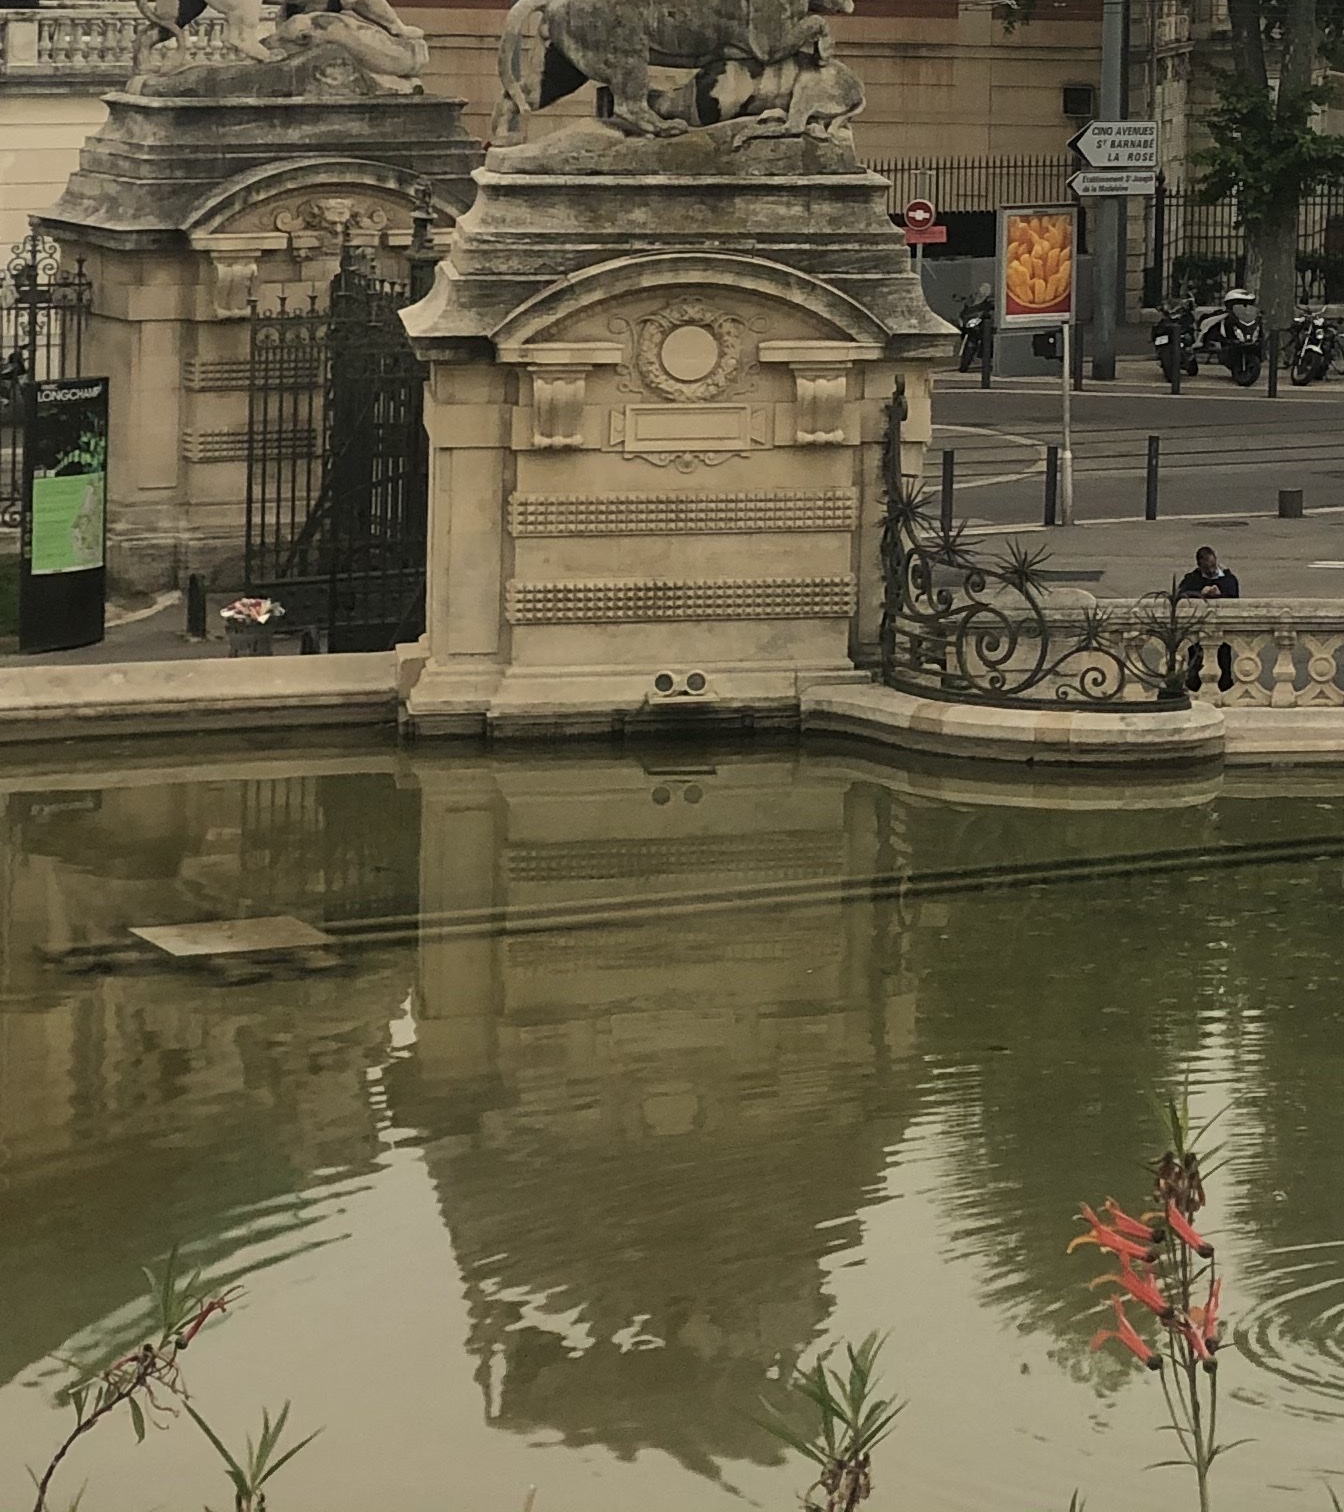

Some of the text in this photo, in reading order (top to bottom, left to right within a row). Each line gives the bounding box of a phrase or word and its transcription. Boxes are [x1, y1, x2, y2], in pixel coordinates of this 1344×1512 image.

[1115, 126, 1154, 136] AVENUES
[1110, 138, 1154, 149] BARNABÉ
[1107, 153, 1154, 162] LA ROSE
[37, 384, 102, 403] LONGCHAMP
